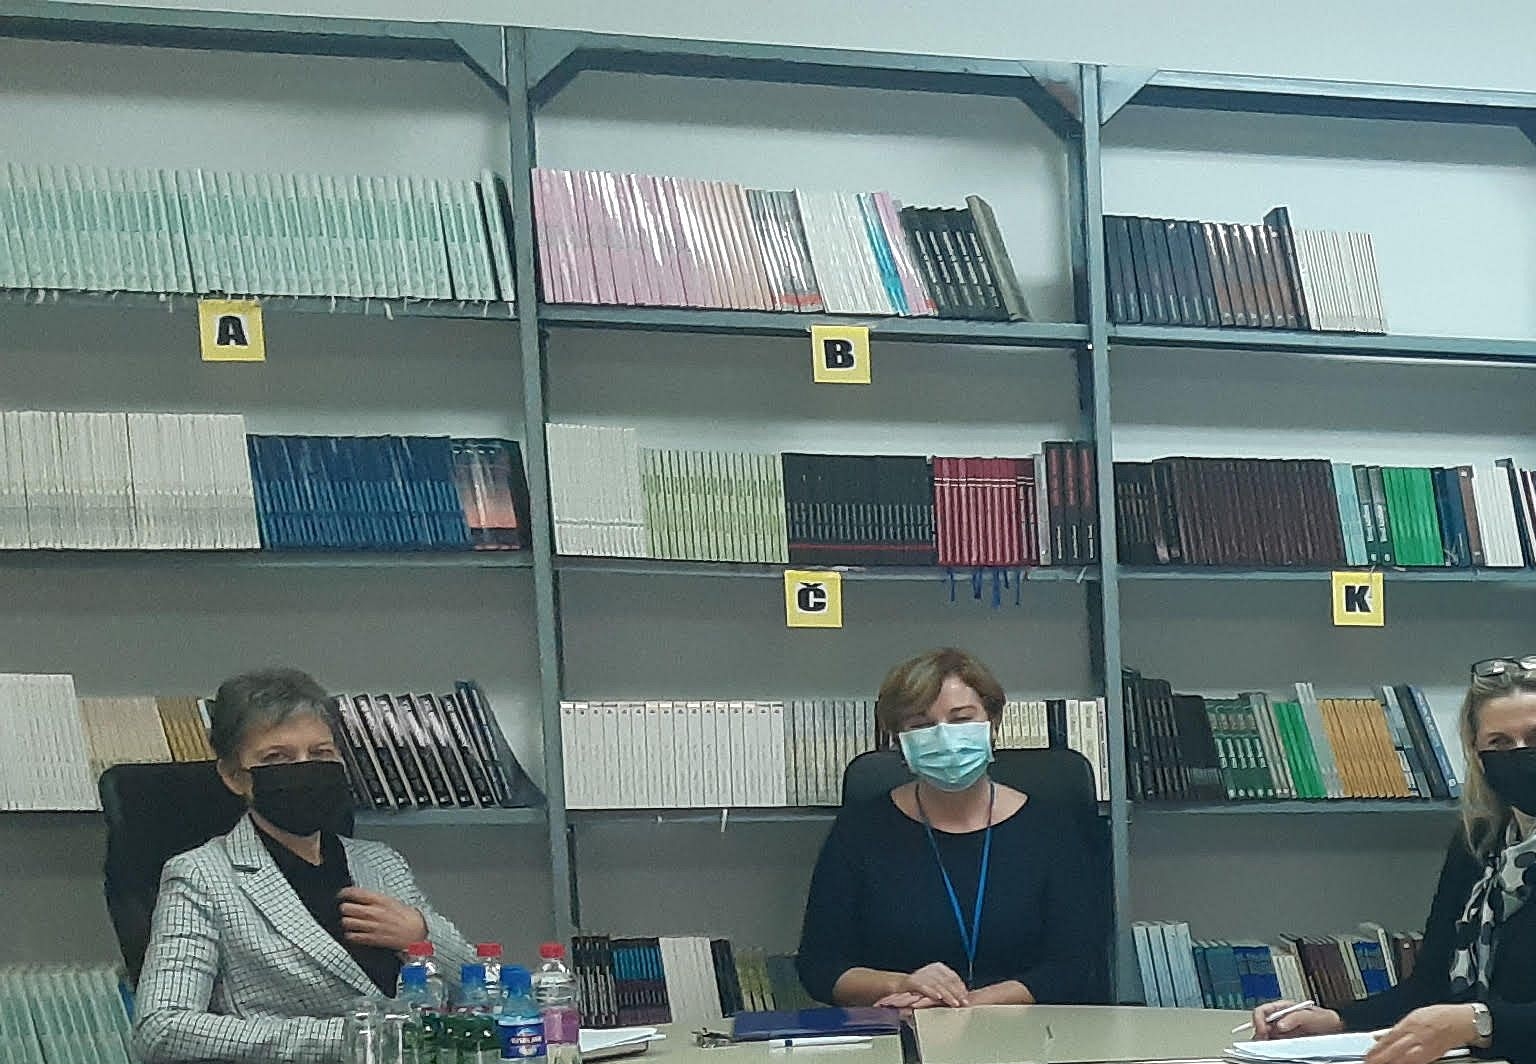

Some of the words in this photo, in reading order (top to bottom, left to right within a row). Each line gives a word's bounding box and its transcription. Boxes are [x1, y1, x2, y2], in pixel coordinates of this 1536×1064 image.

[216, 315, 249, 346] A
[823, 339, 855, 369] B
[797, 581, 827, 612] Č
[1344, 585, 1371, 613] K
